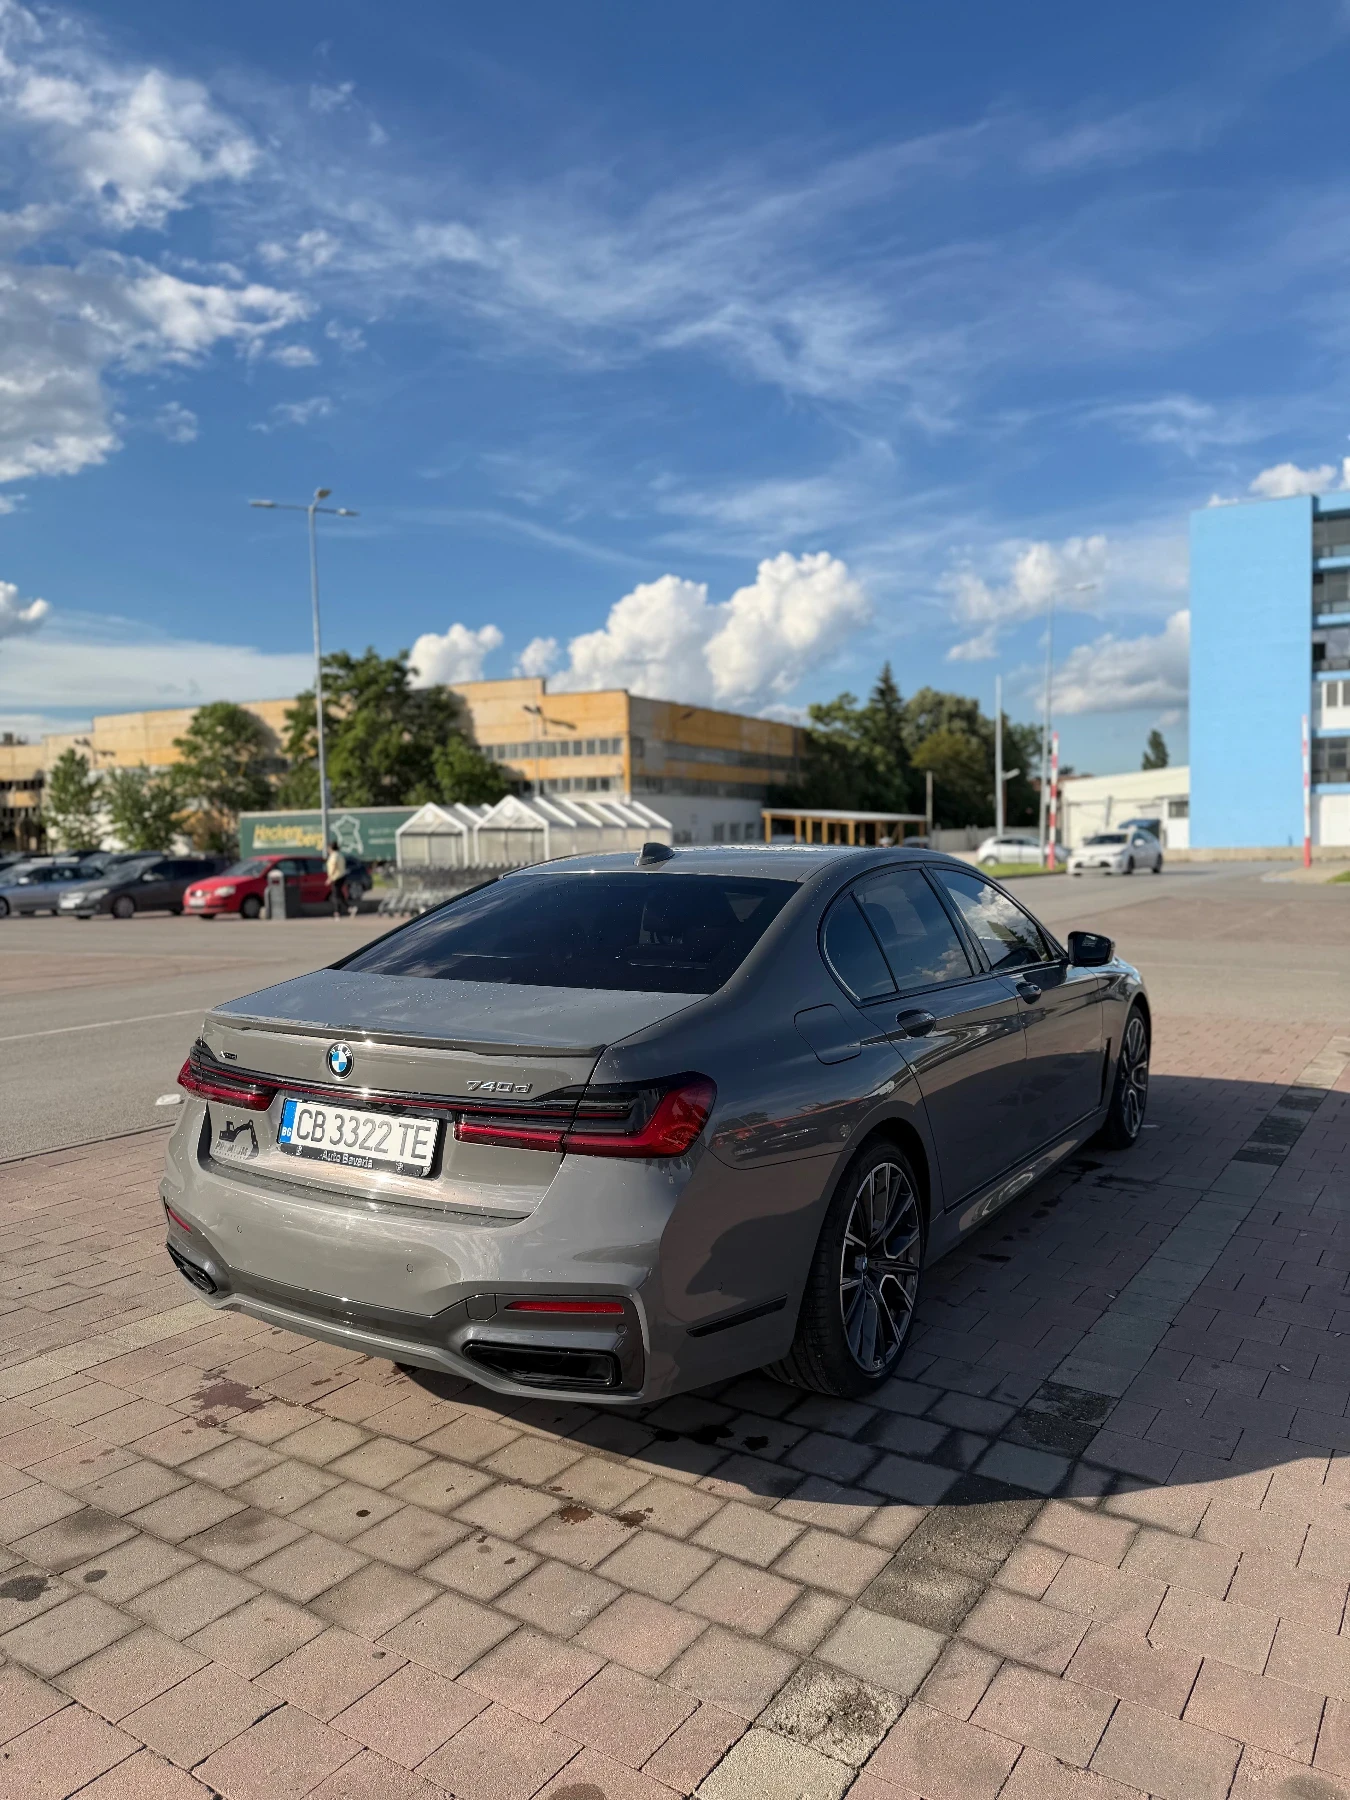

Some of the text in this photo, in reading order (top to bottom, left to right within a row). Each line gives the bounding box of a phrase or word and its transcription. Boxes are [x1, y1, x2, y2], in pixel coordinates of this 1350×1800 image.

[466, 1080, 533, 1094] 740d
[281, 1126, 293, 1137] BG
[296, 1108, 432, 1160] CB 3322 TE
[321, 1150, 373, 1169] Auto Bavaria
